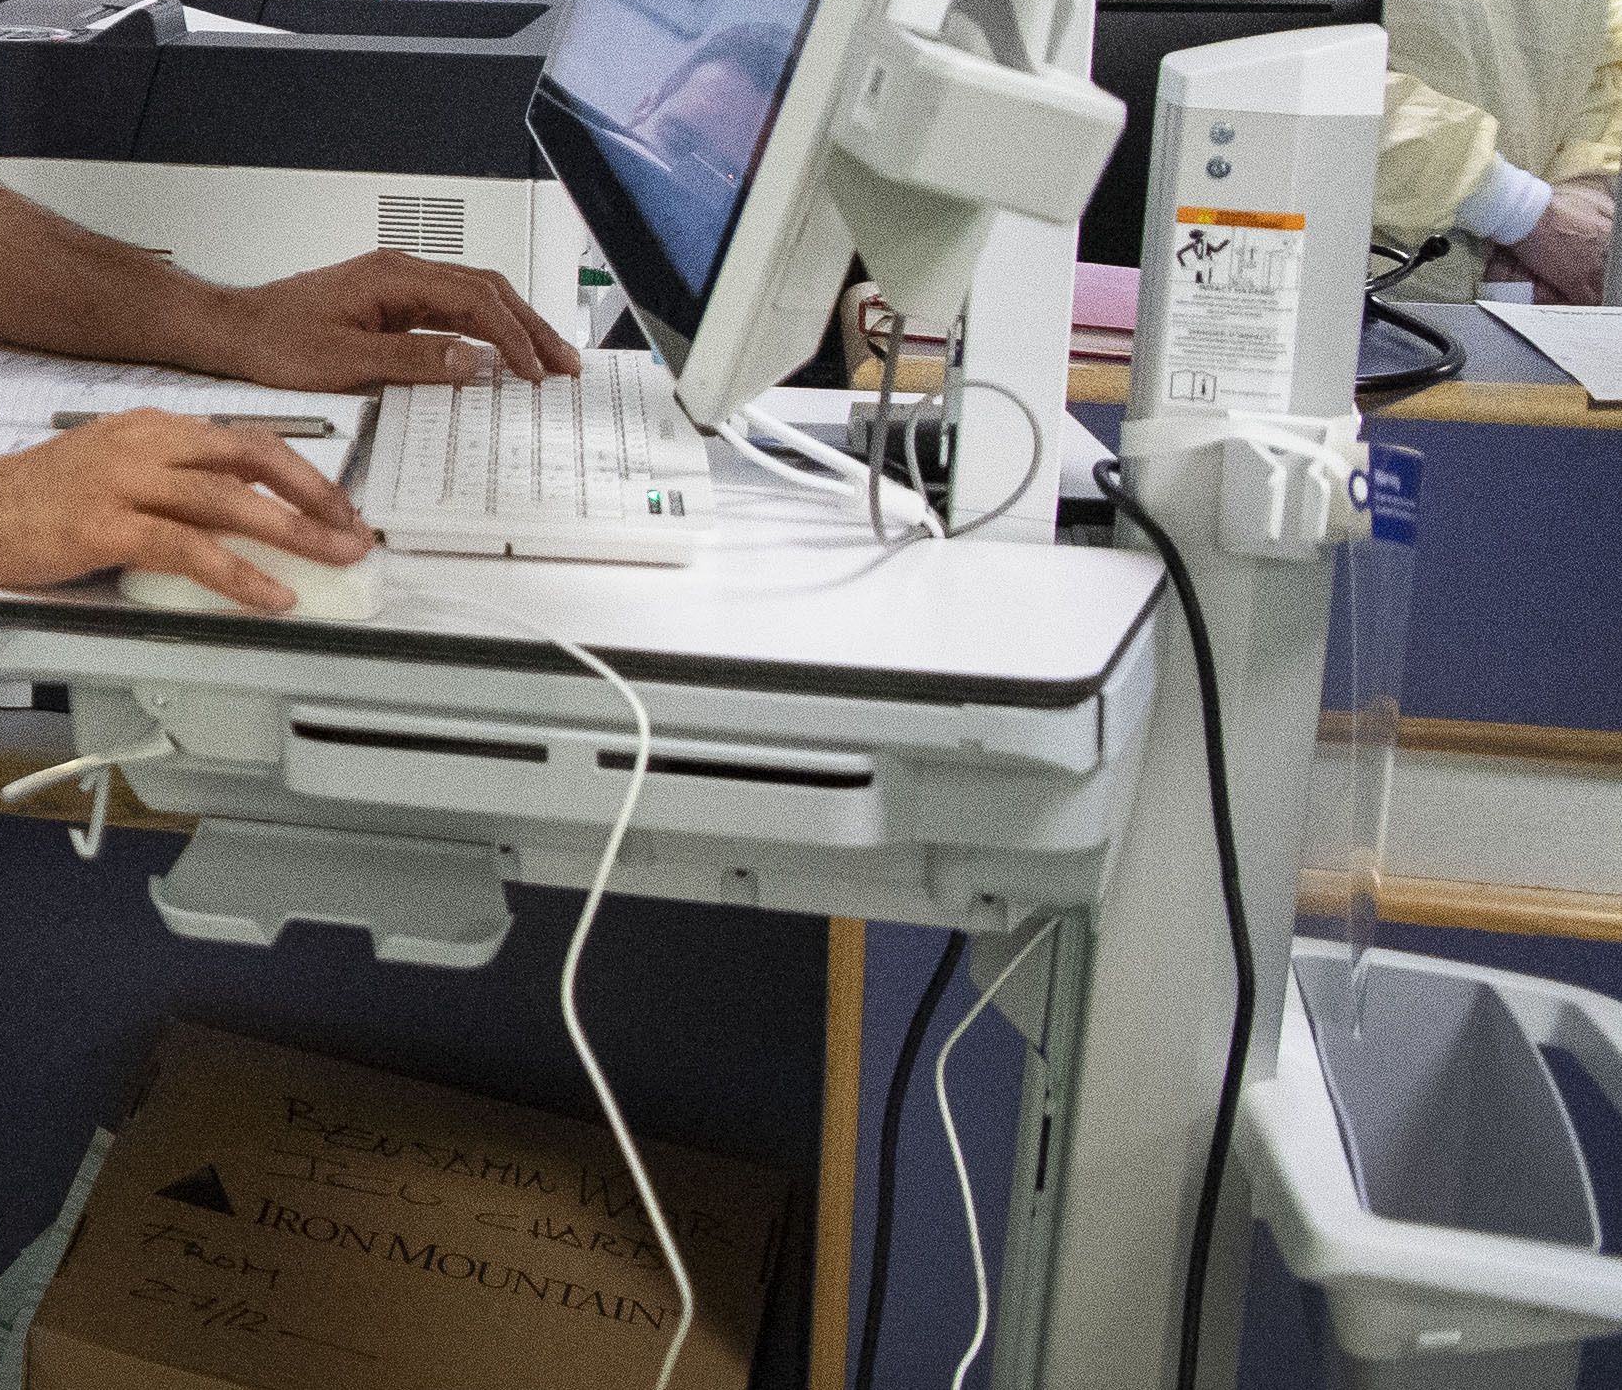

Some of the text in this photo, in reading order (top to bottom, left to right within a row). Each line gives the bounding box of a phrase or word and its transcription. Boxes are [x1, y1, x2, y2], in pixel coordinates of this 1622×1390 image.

[266, 1148, 443, 1207] ICU
[141, 1223, 281, 1290] FROM
[255, 1198, 669, 1331] IRON MOUNTAIN
